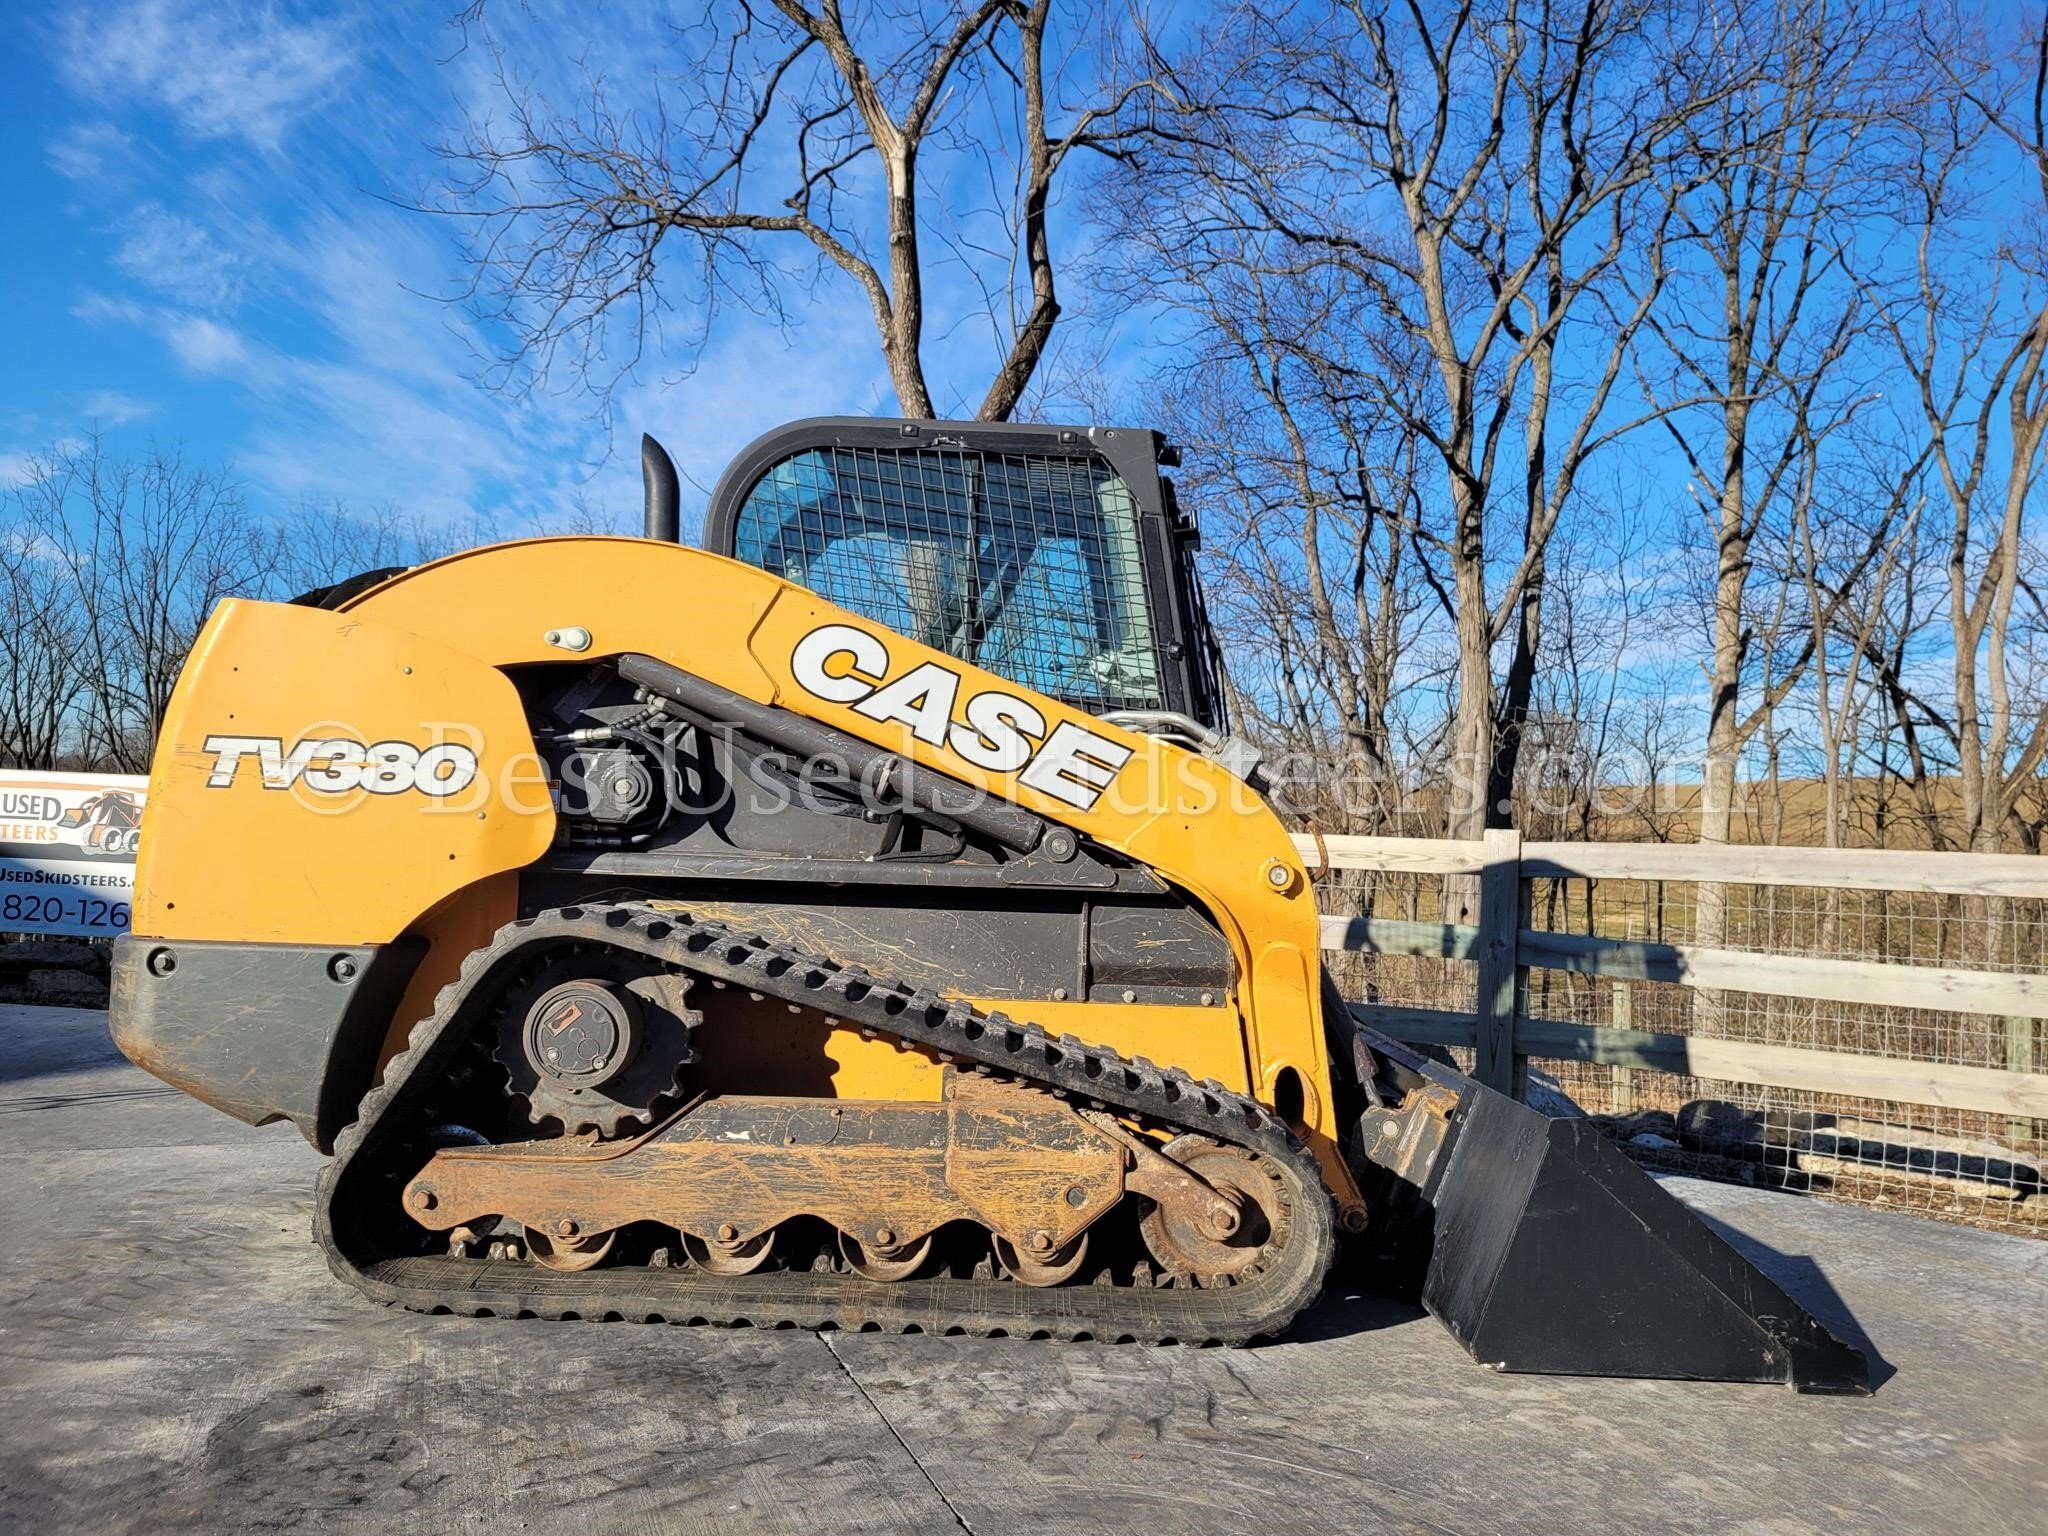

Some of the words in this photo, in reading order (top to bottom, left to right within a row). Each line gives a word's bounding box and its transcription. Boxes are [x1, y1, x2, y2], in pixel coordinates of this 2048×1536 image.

[790, 623, 1136, 812] CASE
[201, 734, 478, 797] TV380
[3, 793, 62, 821] USED
[3, 894, 129, 928] 820-126
